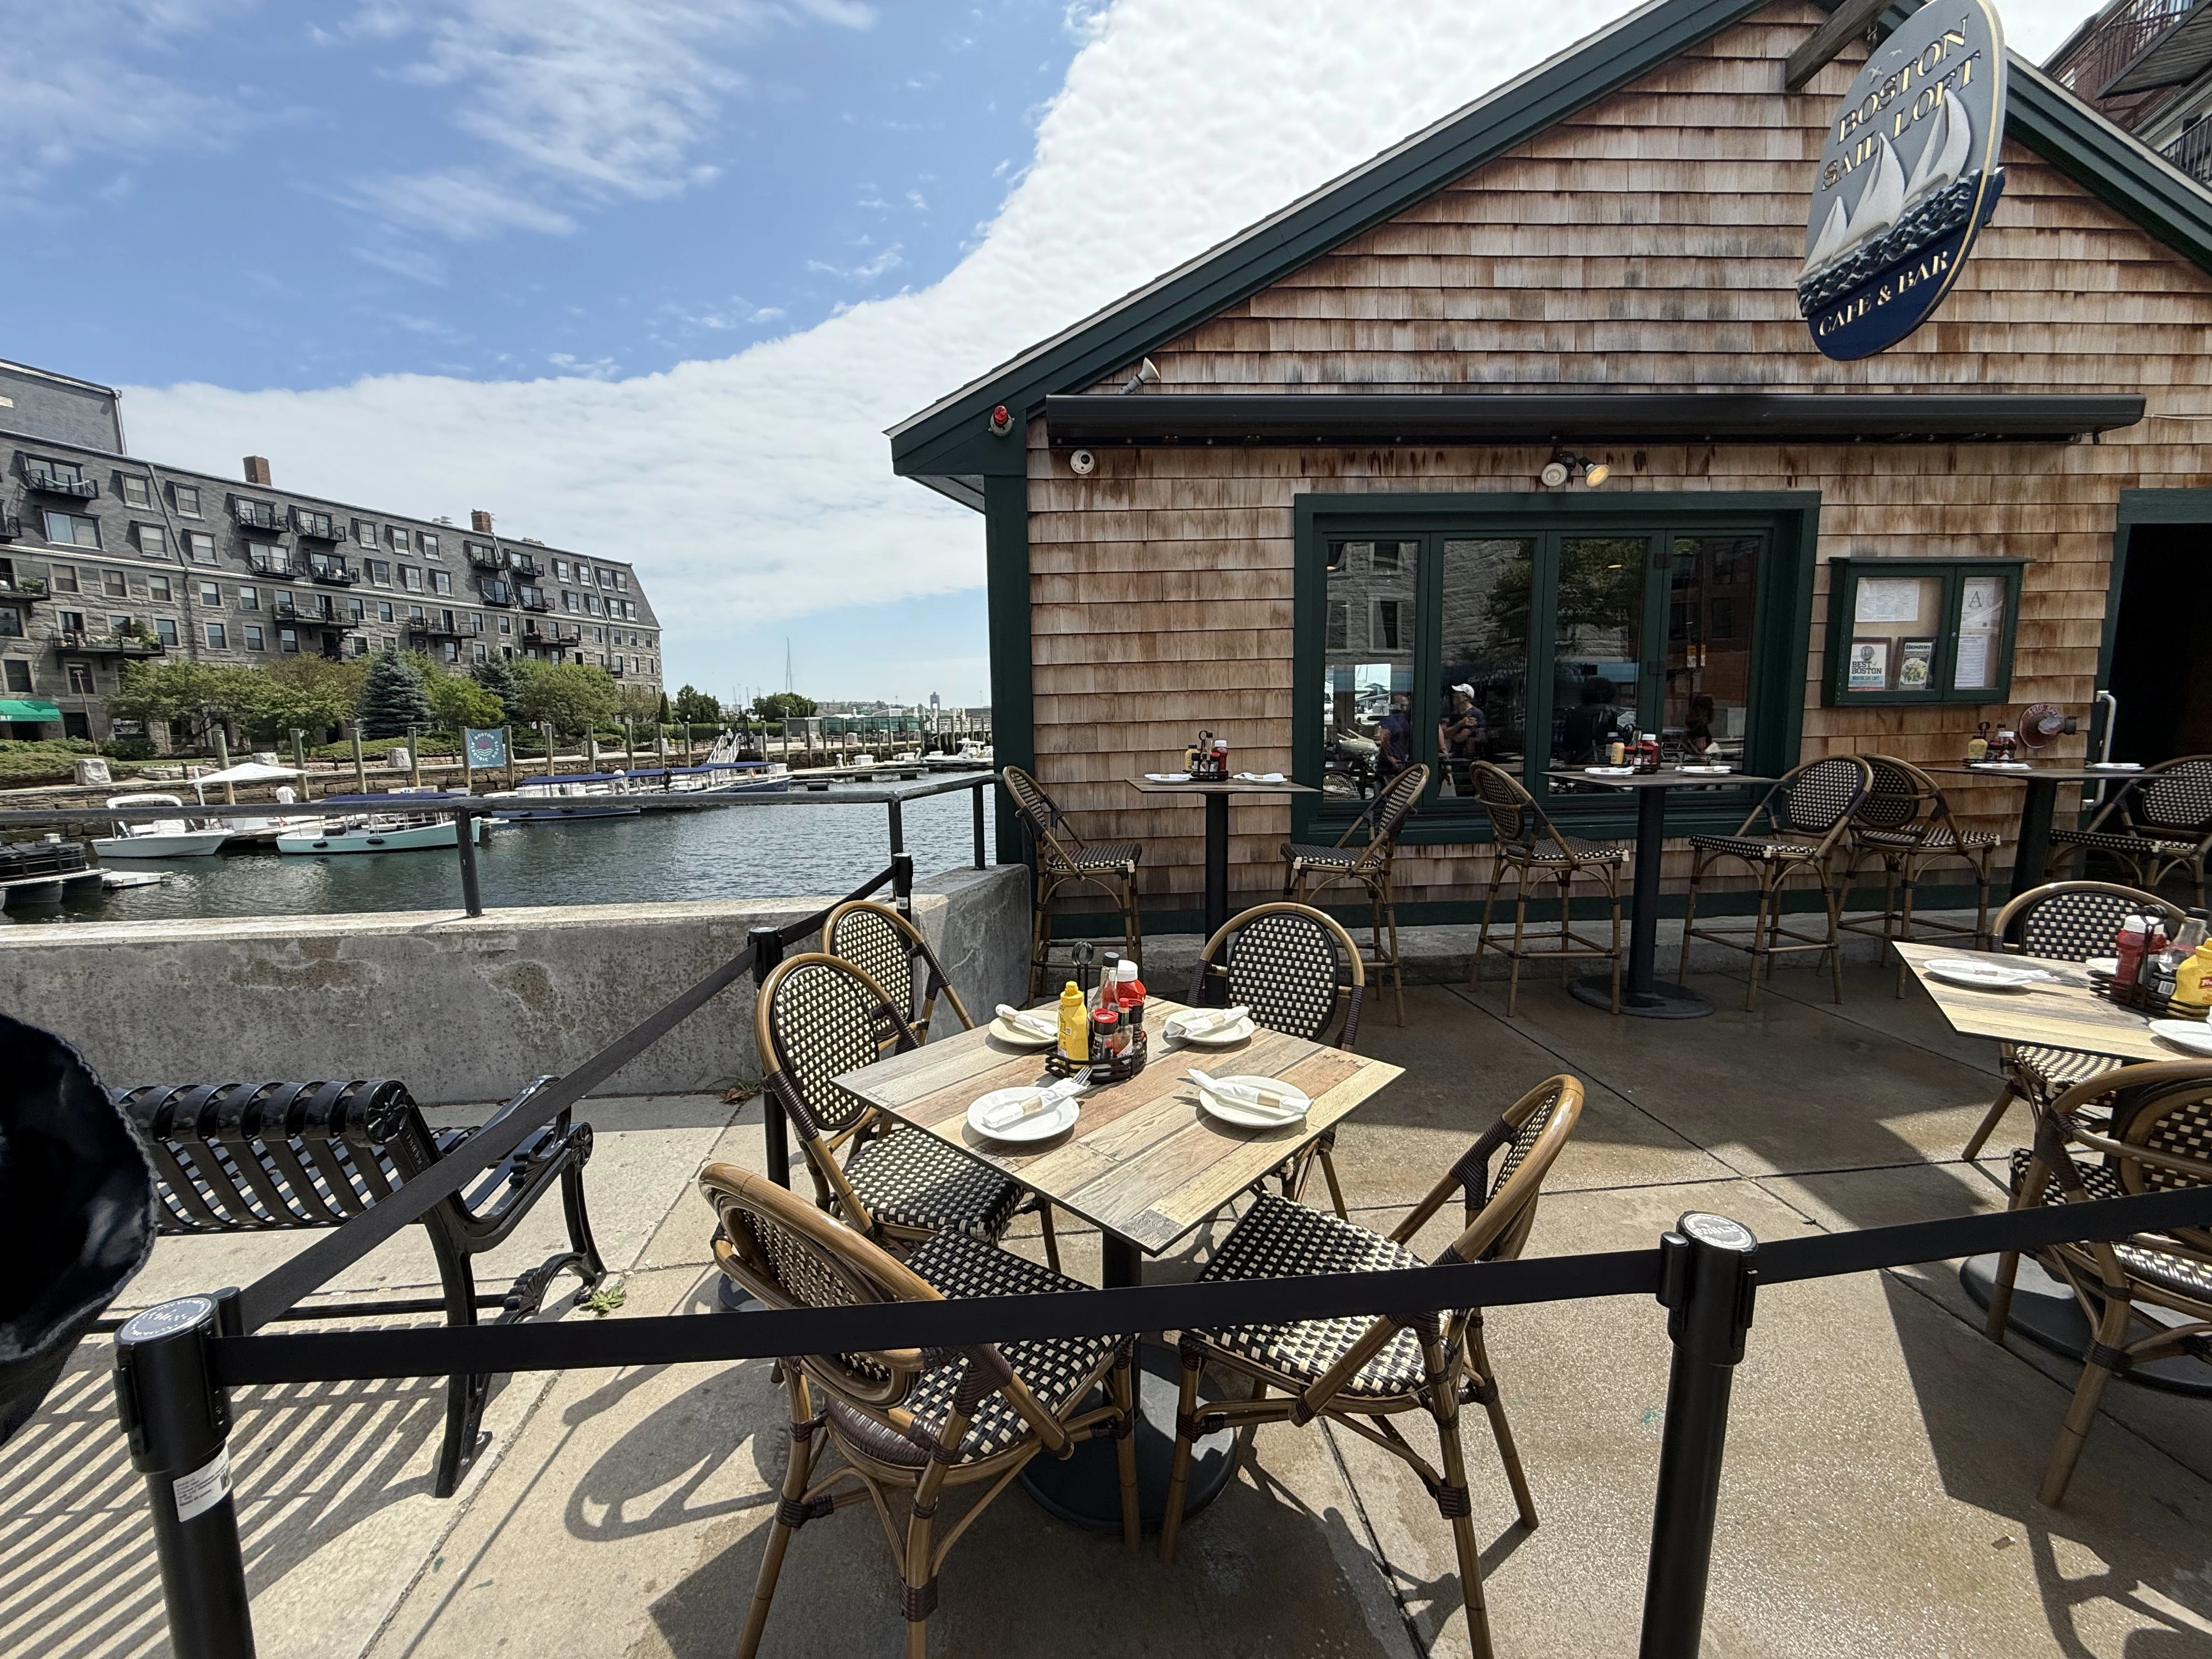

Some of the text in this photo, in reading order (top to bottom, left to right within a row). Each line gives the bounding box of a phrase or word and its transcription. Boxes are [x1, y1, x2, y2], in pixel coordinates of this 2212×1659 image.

[1837, 14, 1969, 145] BOSTON
[1821, 49, 1981, 190] SAIL LOFT
[1819, 250, 1948, 337] CAFE & BAR
[1968, 590, 1983, 607] A
[2028, 704, 2044, 714] AUTO
[471, 742, 488, 761] ELECTRIC
[491, 741, 499, 758] BOATS
